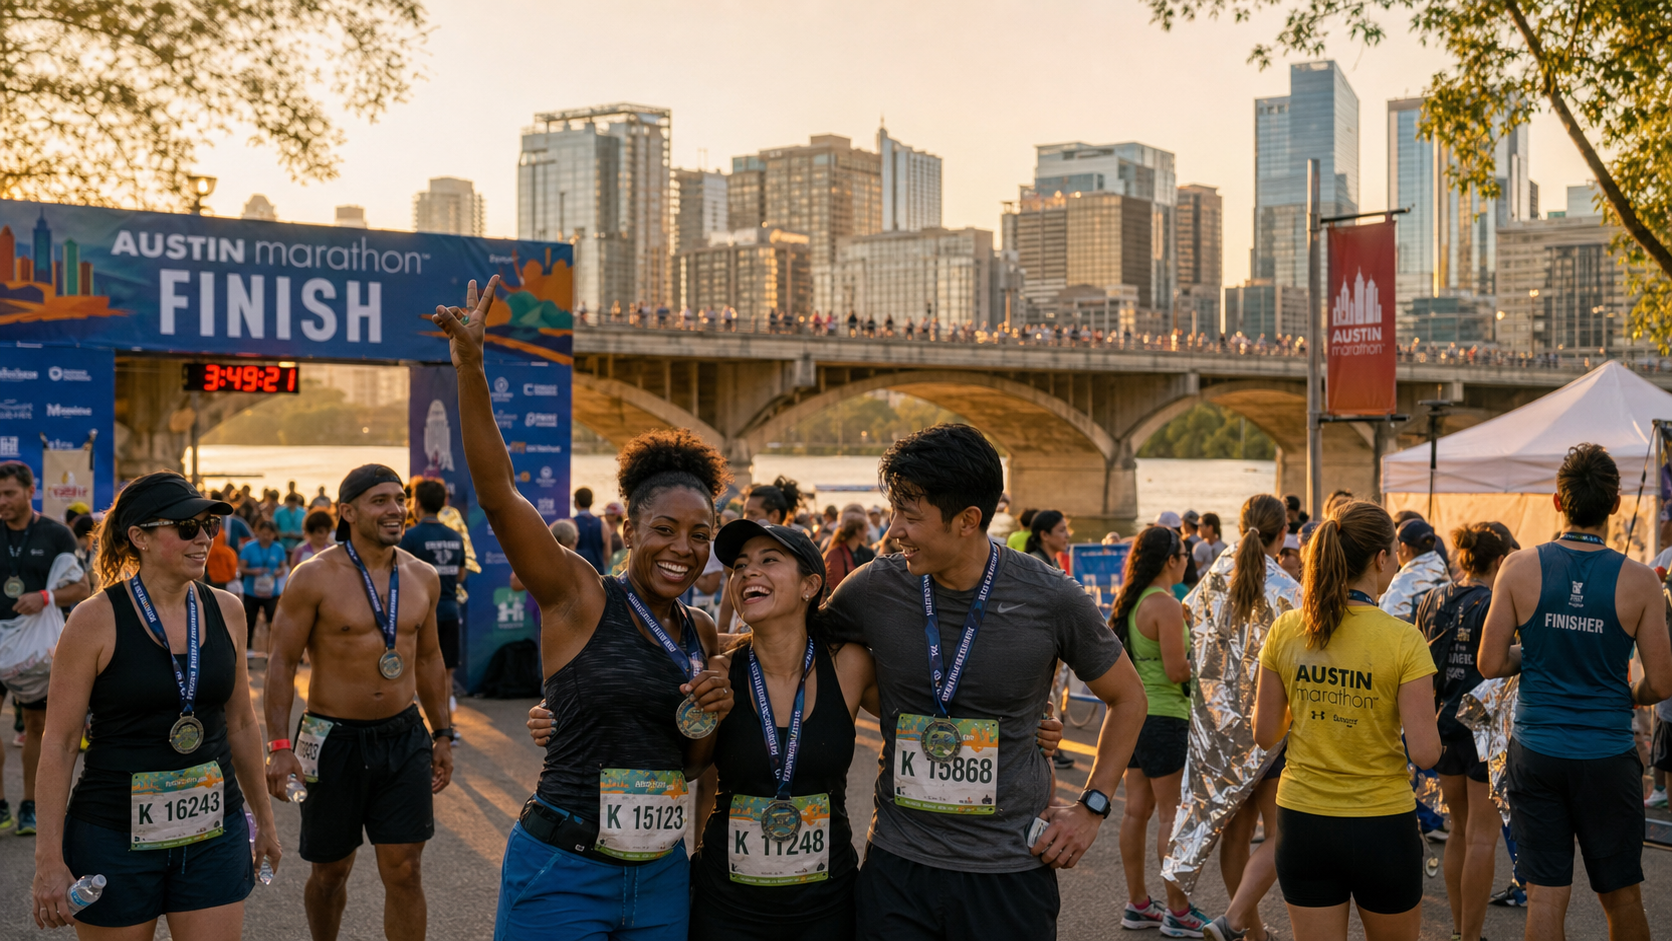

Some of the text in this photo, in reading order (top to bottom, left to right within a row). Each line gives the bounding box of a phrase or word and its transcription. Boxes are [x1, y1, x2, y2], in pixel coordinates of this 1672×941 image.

[111, 230, 245, 263] AUSTIN
[159, 268, 382, 343] FINISH
[1332, 326, 1382, 344] AUSTIN
[203, 364, 296, 393] 3:49:21
[1544, 612, 1604, 634] FINISHER
[1295, 664, 1372, 690] AUSTIN
[901, 750, 993, 784] K 15868
[138, 791, 220, 825] K 16243
[607, 804, 683, 830] K 15123
[735, 830, 750, 855] K
